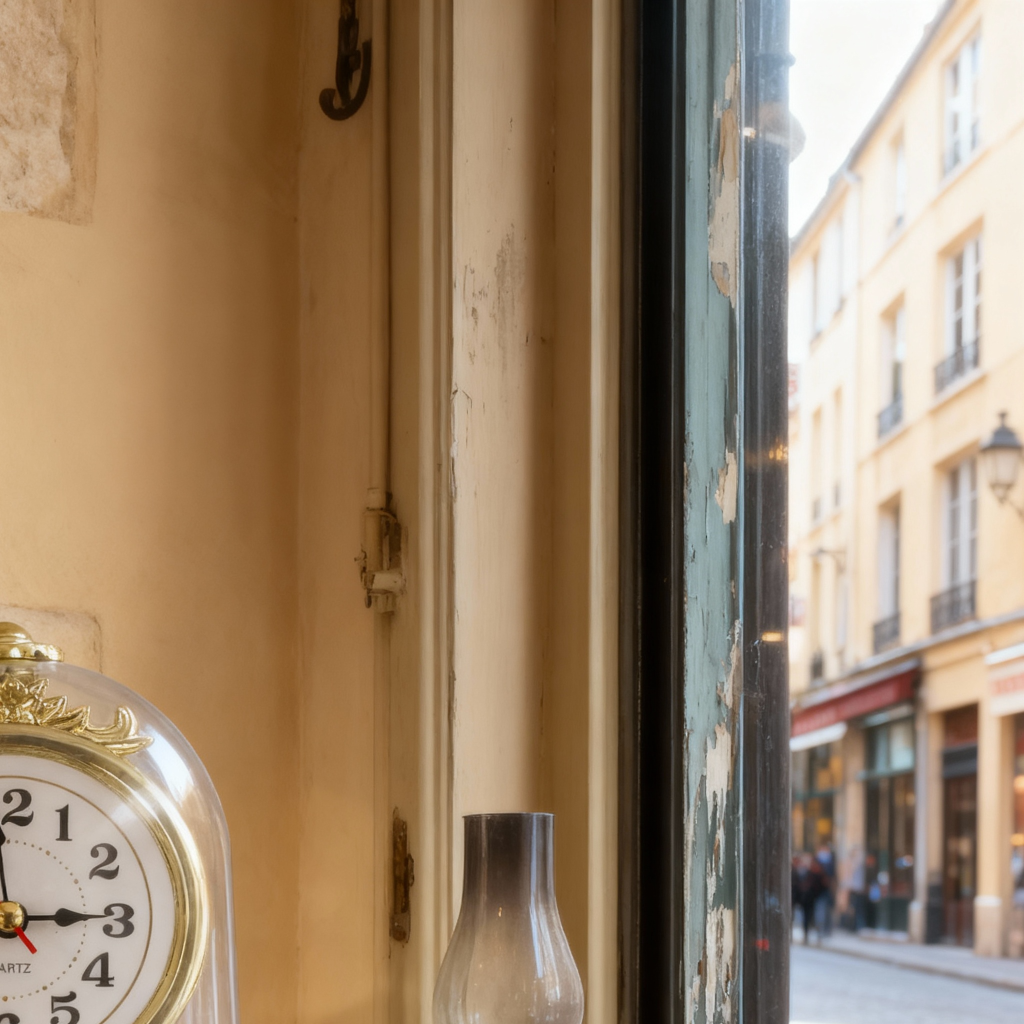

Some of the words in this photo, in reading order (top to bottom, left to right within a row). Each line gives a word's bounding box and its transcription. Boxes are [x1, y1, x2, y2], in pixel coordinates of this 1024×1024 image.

[55, 804, 73, 842] 1
[90, 843, 120, 880] 2
[102, 903, 135, 938] 3
[82, 952, 115, 987] 4
